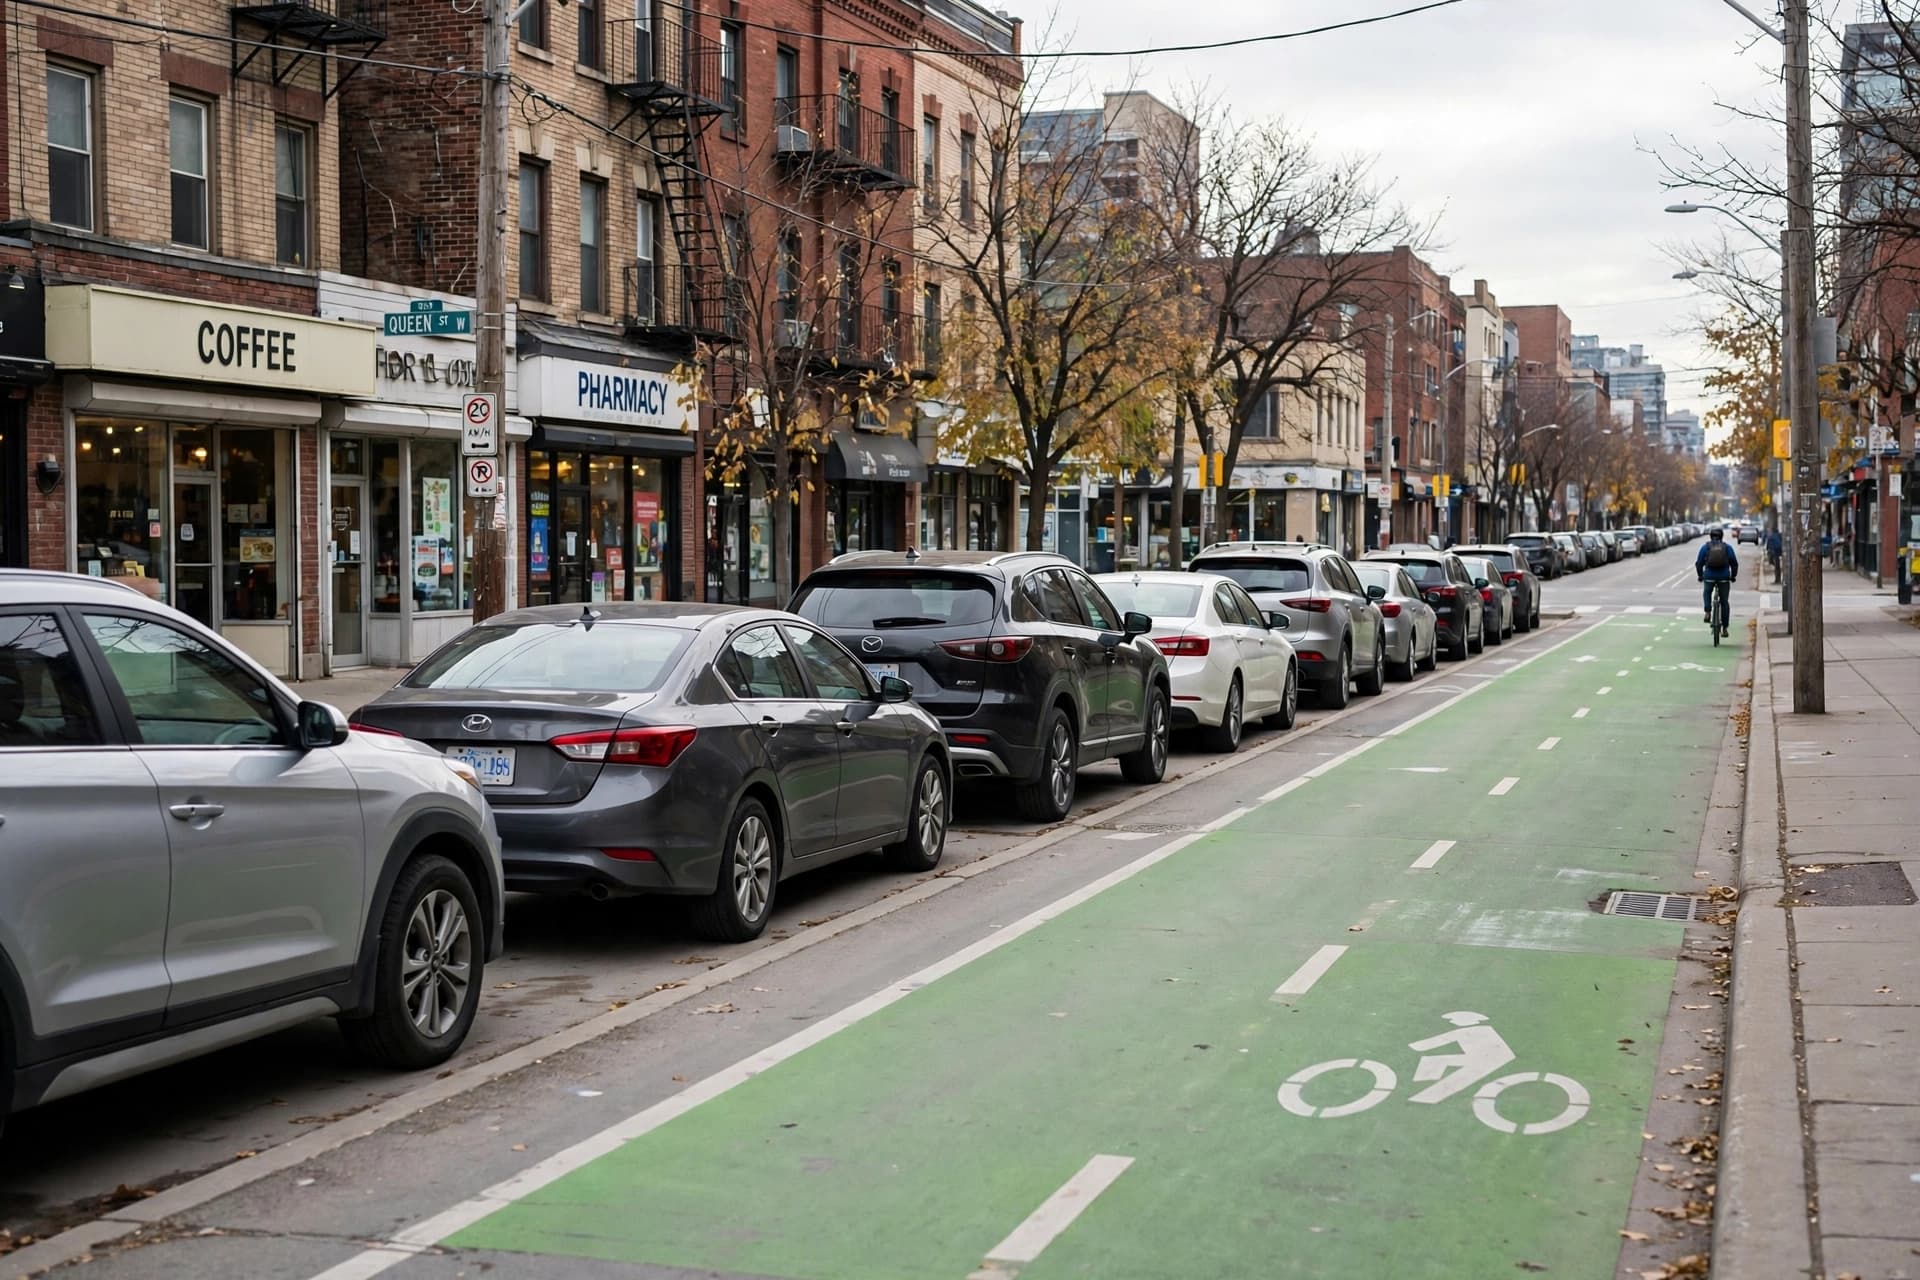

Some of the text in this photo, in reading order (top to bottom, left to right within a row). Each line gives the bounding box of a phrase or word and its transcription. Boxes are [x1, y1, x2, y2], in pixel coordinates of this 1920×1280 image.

[389, 314, 465, 333] QUEEN ST W
[198, 320, 296, 372] COFFEE
[578, 371, 668, 415] PHARMACY
